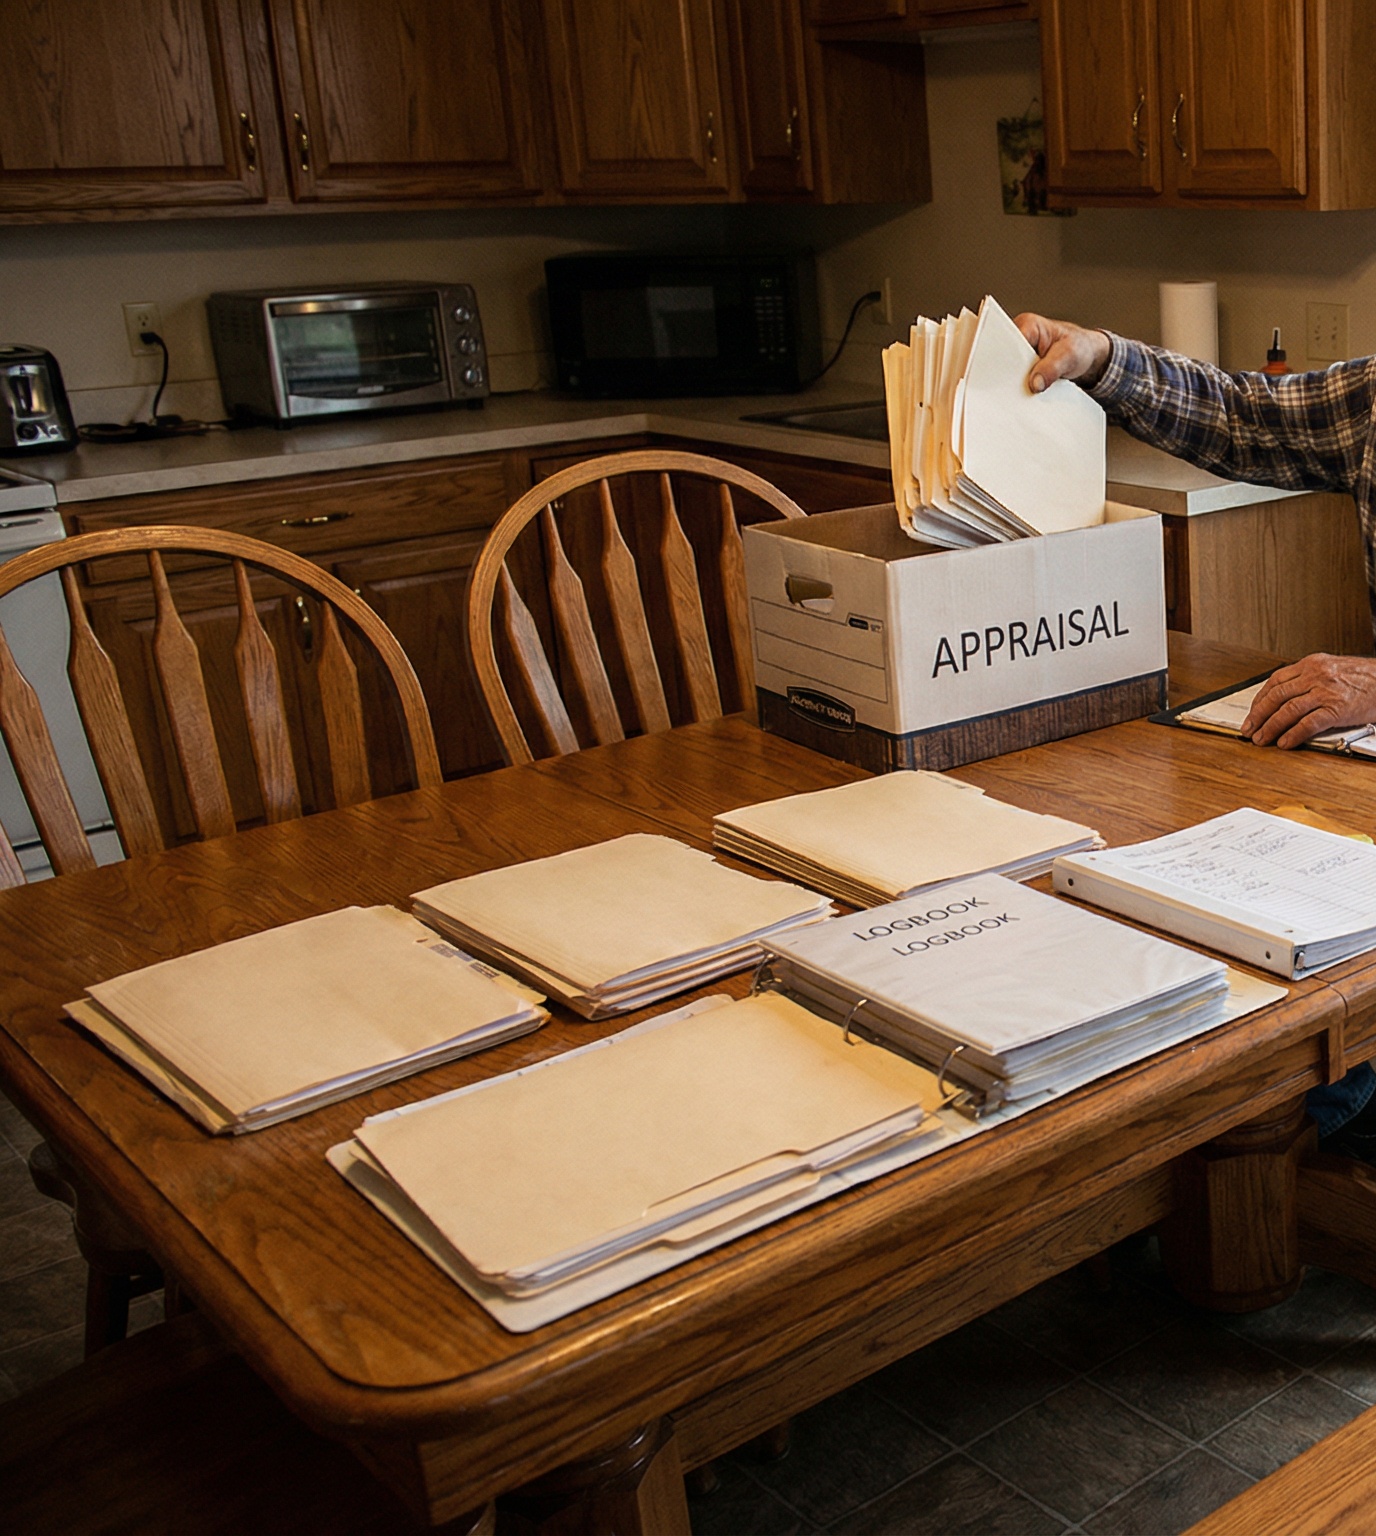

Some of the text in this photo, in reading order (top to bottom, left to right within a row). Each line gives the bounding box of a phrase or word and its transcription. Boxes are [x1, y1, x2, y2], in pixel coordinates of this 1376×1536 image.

[932, 600, 1129, 678] APPRAISAL
[853, 897, 989, 941] LOGBOOK
[892, 913, 1020, 956] LOGBOOK
